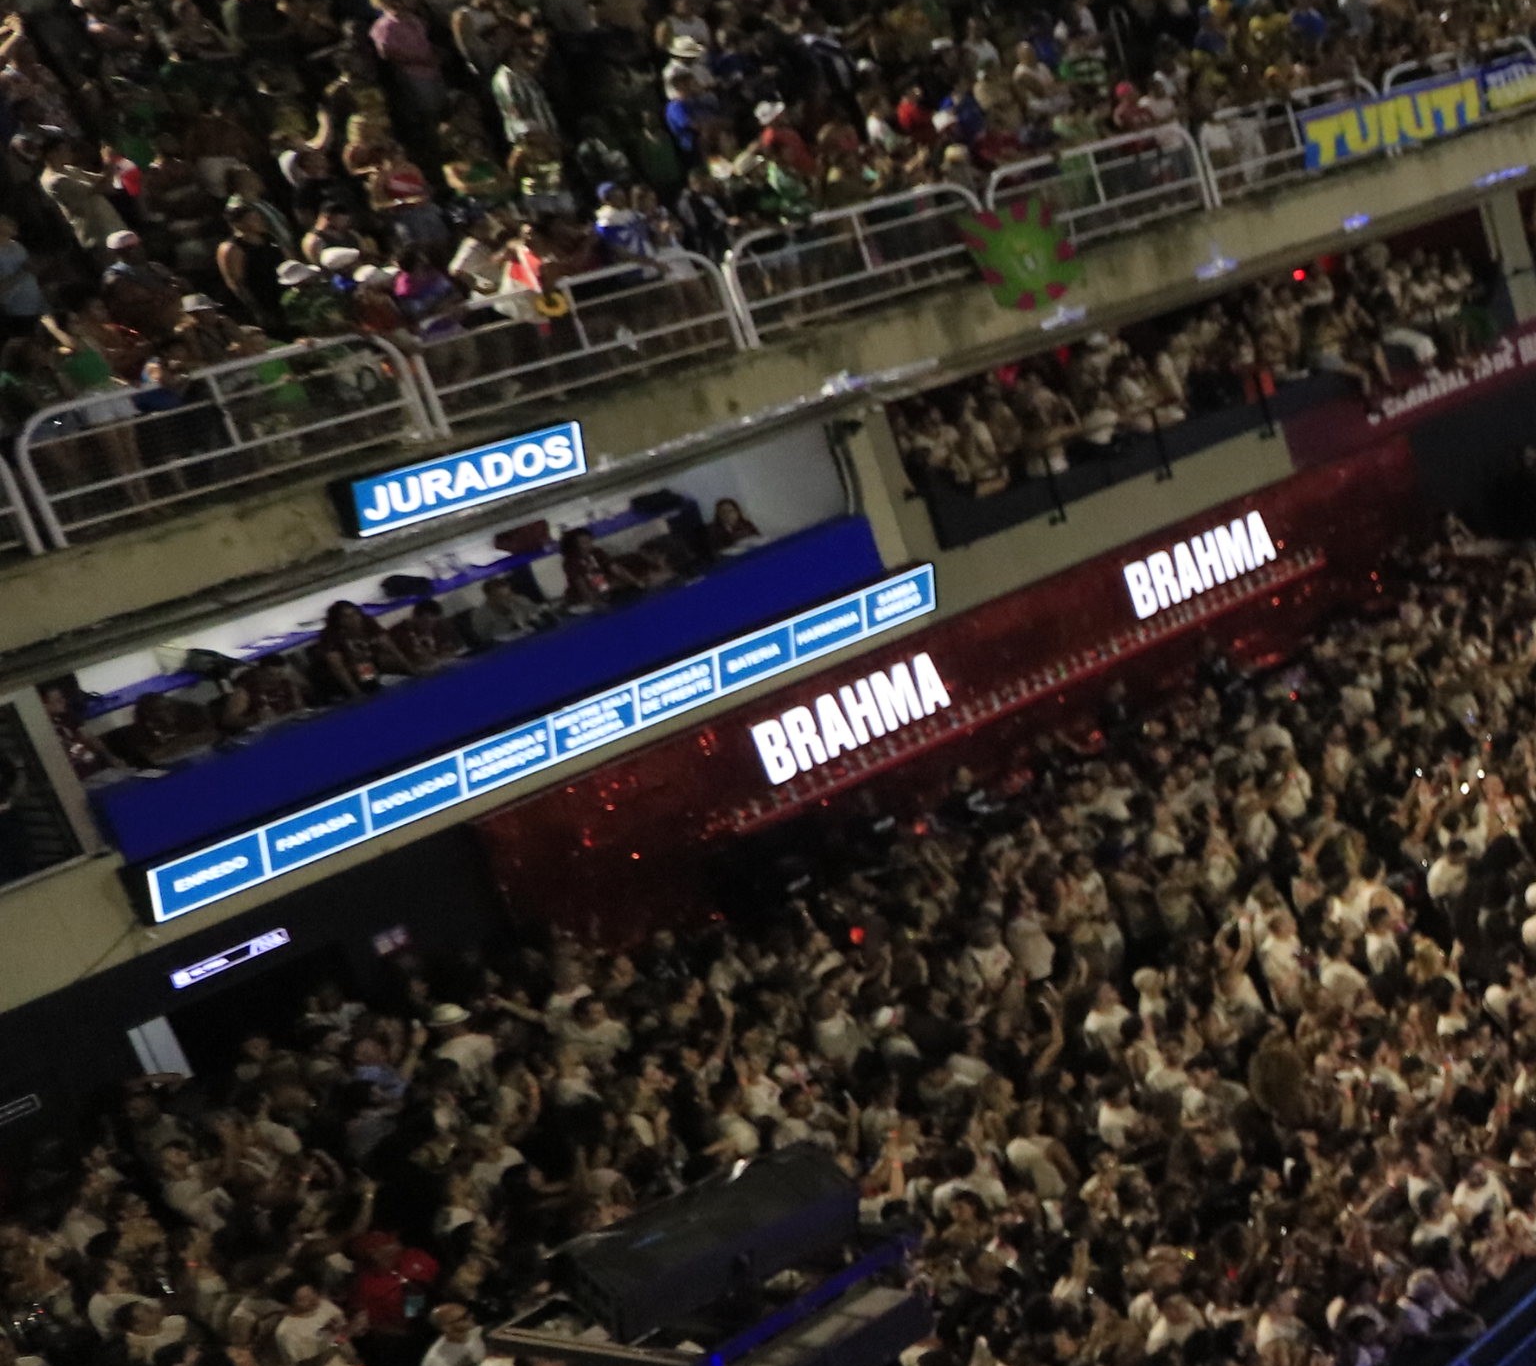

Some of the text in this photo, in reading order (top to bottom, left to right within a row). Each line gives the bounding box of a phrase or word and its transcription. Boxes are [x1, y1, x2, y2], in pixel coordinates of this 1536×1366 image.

[1306, 78, 1481, 166] TUIUTI
[363, 435, 573, 521] JURADOS
[1123, 510, 1277, 620] BRAHMA
[877, 580, 918, 607] SAMBA
[795, 611, 860, 647] HARMONIA
[726, 643, 781, 673] BATERIA
[640, 664, 710, 699] COMISSÃO
[641, 676, 712, 715] DE FRENTE
[601, 692, 632, 712] SALA
[751, 652, 952, 786] BRAHMA
[465, 728, 548, 770] ALEGORIA E
[275, 813, 357, 852] FANTASIA
[173, 855, 249, 893] ENREDO
